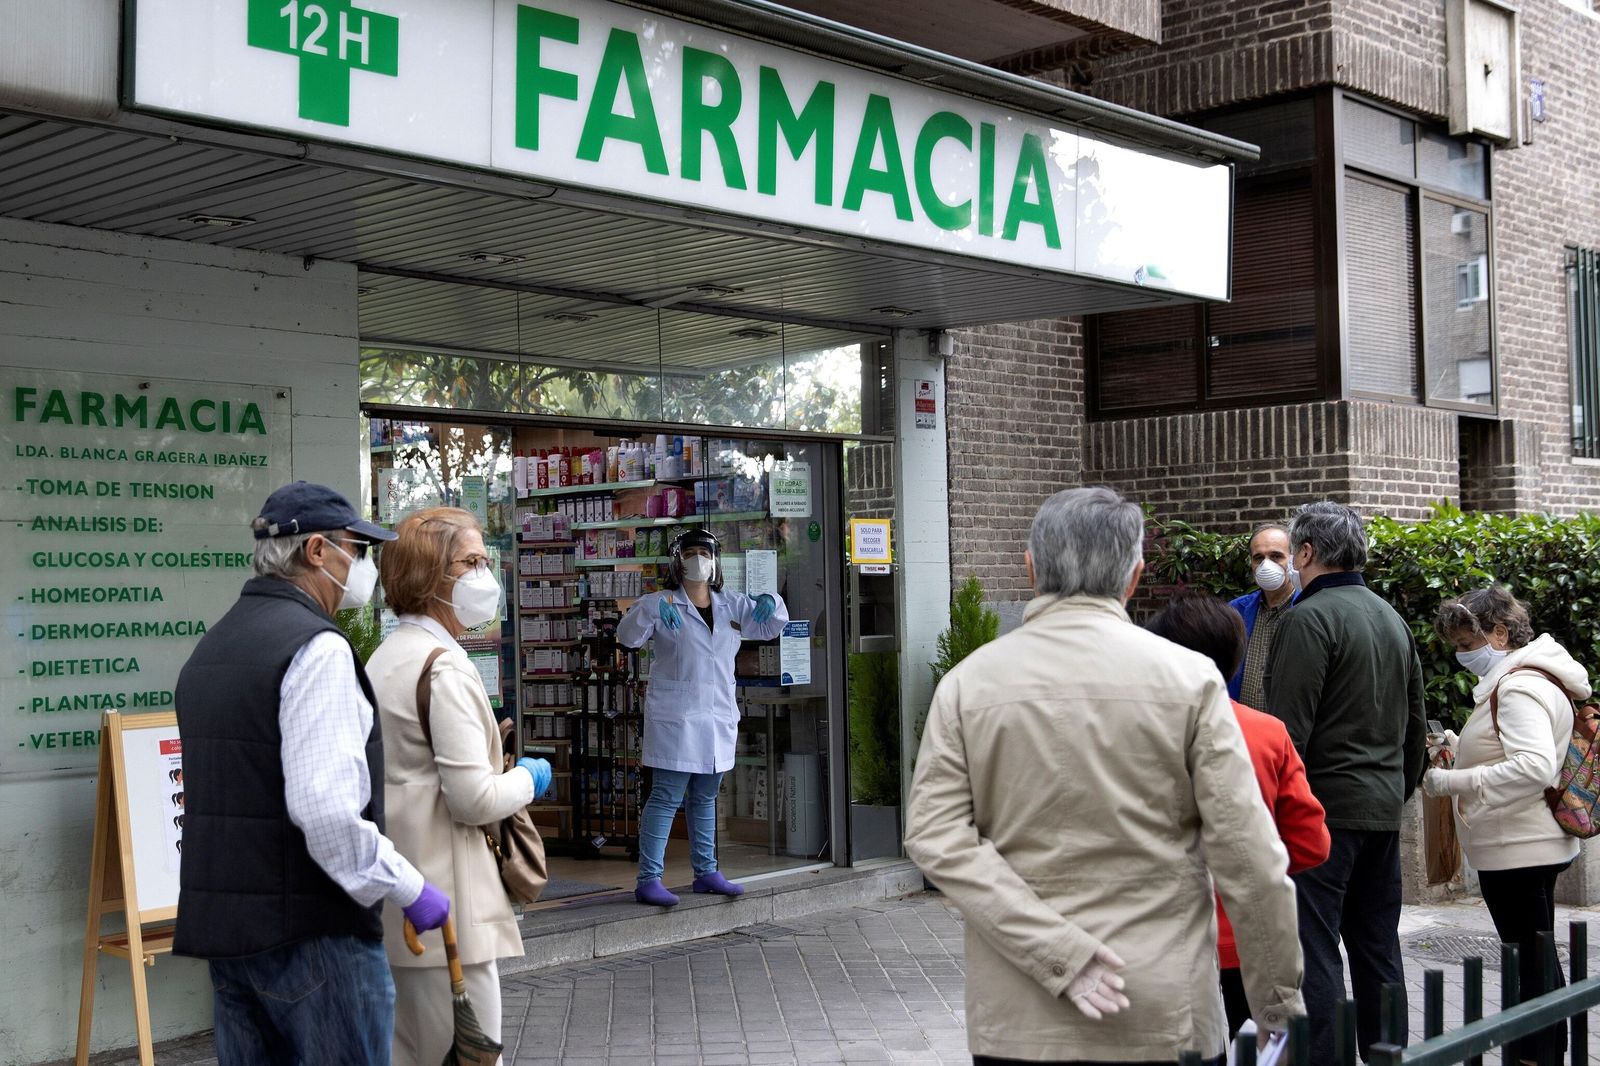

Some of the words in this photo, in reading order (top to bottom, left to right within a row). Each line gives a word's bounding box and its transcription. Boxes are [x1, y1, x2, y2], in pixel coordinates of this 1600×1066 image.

[280, 0, 328, 56] 12
[339, 11, 369, 65] H
[515, 7, 1060, 248] FARMACIA
[15, 387, 267, 436] FARMACIA
[16, 445, 54, 458] LDA.
[60, 447, 128, 461] BLANCA
[134, 450, 208, 465] GRAGERA
[214, 451, 268, 467] IBAÑEZ
[96, 481, 120, 497] DE
[129, 482, 214, 500] TENSION
[31, 516, 126, 532] ANALISIS
[133, 518, 163, 533] DE:
[32, 552, 130, 568] GLUCOSA
[134, 553, 146, 567] Y
[31, 587, 164, 604] HOMEOPATIA
[32, 621, 207, 640] DERMOFARMACIA
[32, 657, 140, 677] DIETETICA
[32, 692, 127, 713] PLANTAS
[133, 690, 173, 708] MED
